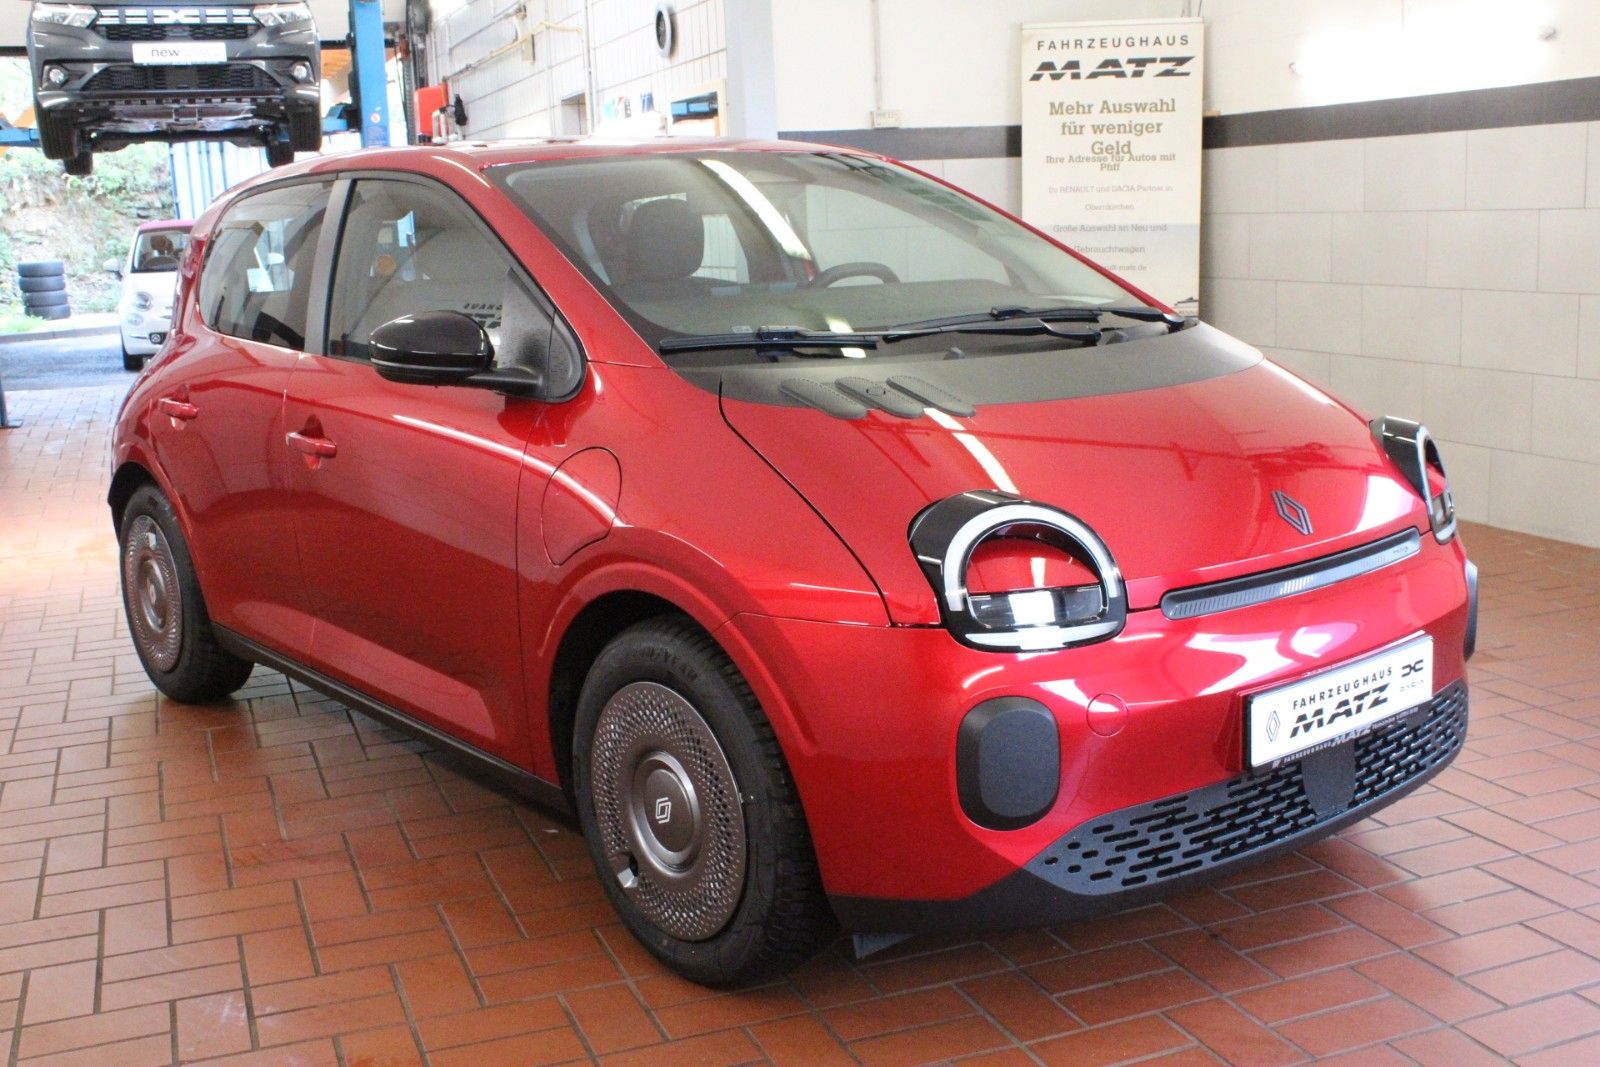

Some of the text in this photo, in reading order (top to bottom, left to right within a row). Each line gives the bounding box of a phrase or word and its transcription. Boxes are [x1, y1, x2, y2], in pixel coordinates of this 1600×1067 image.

[1037, 35, 1189, 51] FAHRZEUGHAUS
[151, 48, 180, 57] new
[1029, 56, 1195, 81] MATZ
[1049, 98, 1176, 115] Mehr Auswahl
[1061, 121, 1163, 136] für weniger
[1091, 141, 1131, 156] Geld
[1046, 153, 1176, 164] Ihre Adresse für Autos mit
[1079, 223, 1116, 232] Auswahl
[1293, 666, 1392, 710] FAHRZEUGHAUS
[1289, 682, 1390, 738] MATZ
